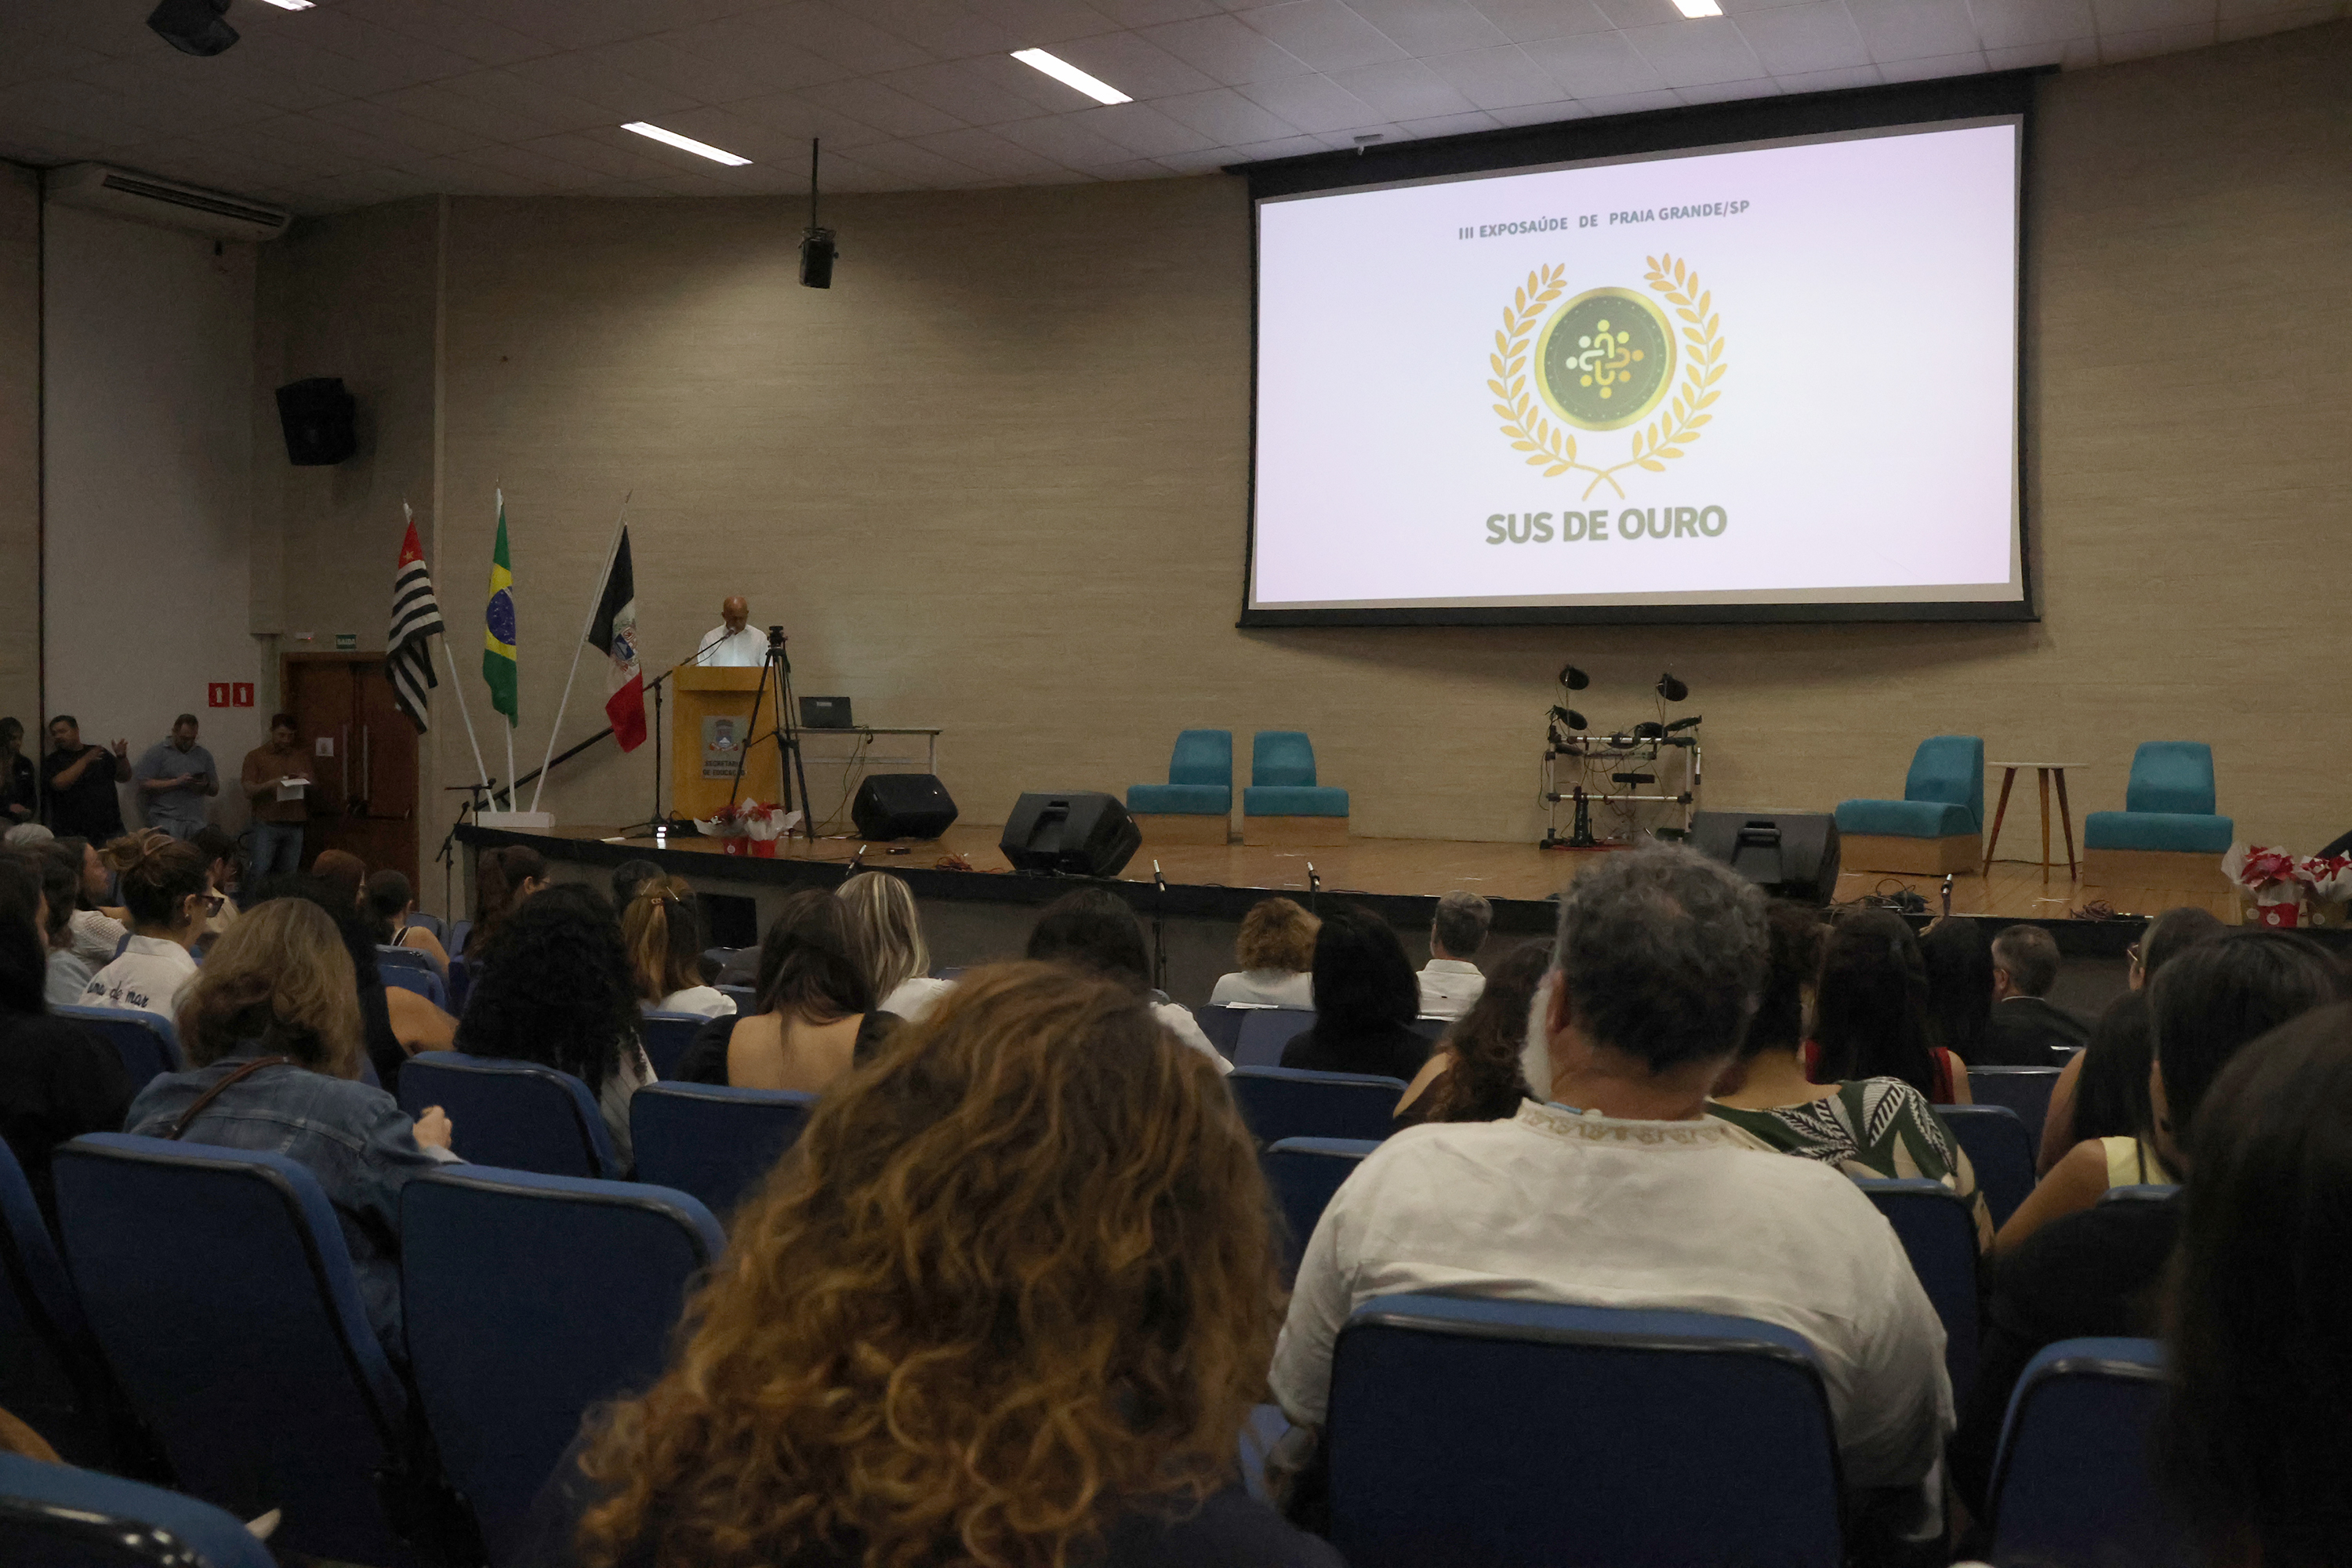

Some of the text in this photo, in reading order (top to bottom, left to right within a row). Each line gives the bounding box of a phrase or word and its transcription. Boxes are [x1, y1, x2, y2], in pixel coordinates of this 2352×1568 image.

[1459, 200, 1750, 240] III EXPOSAÚDE DE PRAIA GRANDE/SP
[1485, 505, 1728, 545] SUS DE OURO
[110, 981, 123, 1000] de
[125, 990, 149, 1007] mar
